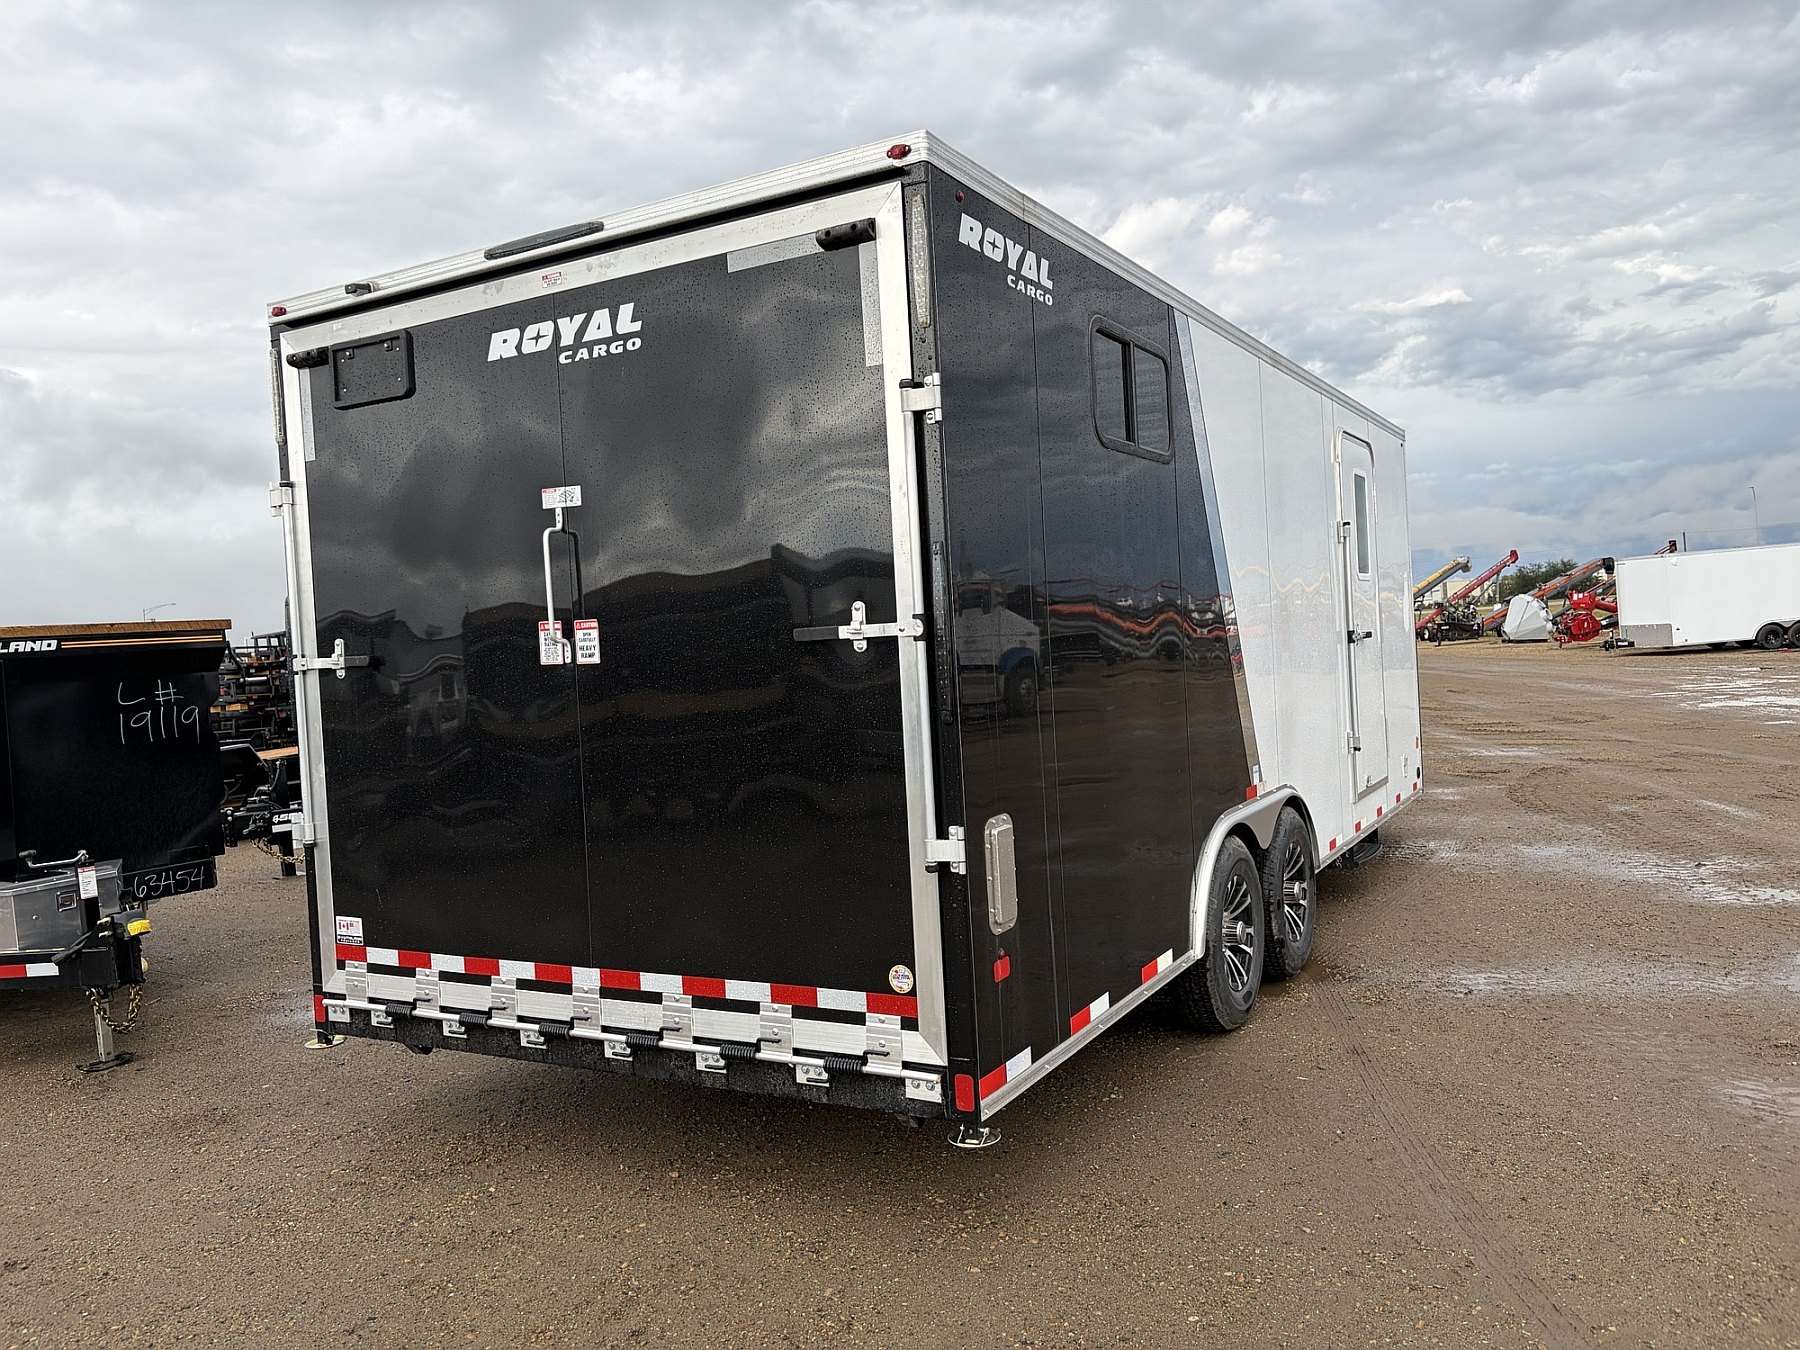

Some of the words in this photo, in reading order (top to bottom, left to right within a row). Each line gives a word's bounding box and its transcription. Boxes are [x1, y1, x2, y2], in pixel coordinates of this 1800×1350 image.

[958, 212, 1054, 290] ROYAL
[1007, 274, 1053, 306] CARGO
[487, 302, 643, 362] ROYAL
[558, 337, 642, 365] CARGO
[579, 644, 596, 652] HEAVY
[134, 865, 205, 898] 63454
